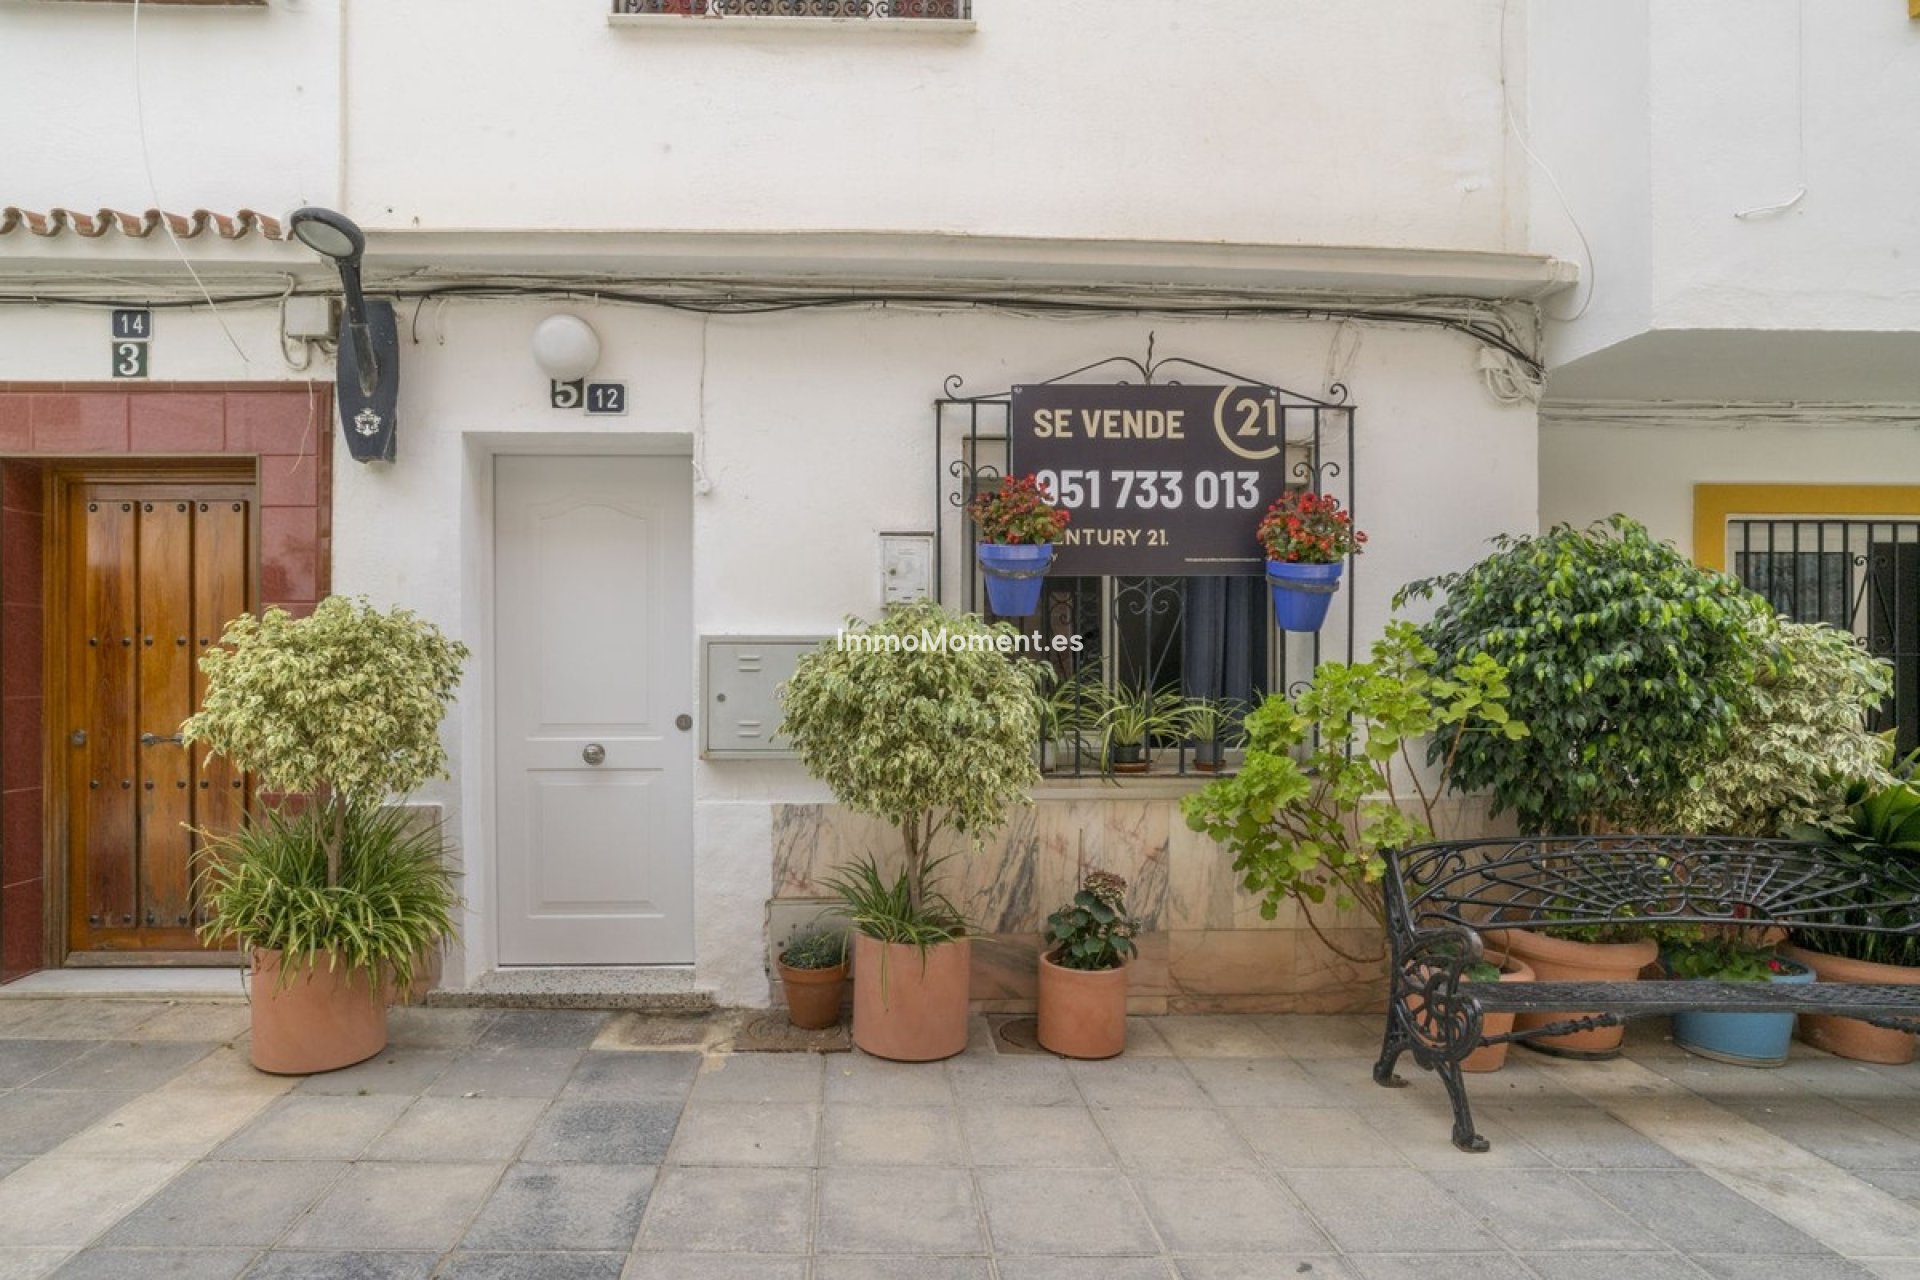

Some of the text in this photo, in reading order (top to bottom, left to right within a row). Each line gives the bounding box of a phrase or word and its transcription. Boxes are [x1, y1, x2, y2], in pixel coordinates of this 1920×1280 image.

[121, 314, 144, 334] 14
[119, 343, 139, 376] 3
[554, 379, 578, 408] 5
[596, 388, 619, 409] 12
[1033, 408, 1185, 439] SE VENDE
[1036, 469, 1260, 509] 951 733 013
[1051, 528, 1142, 546] NTURY
